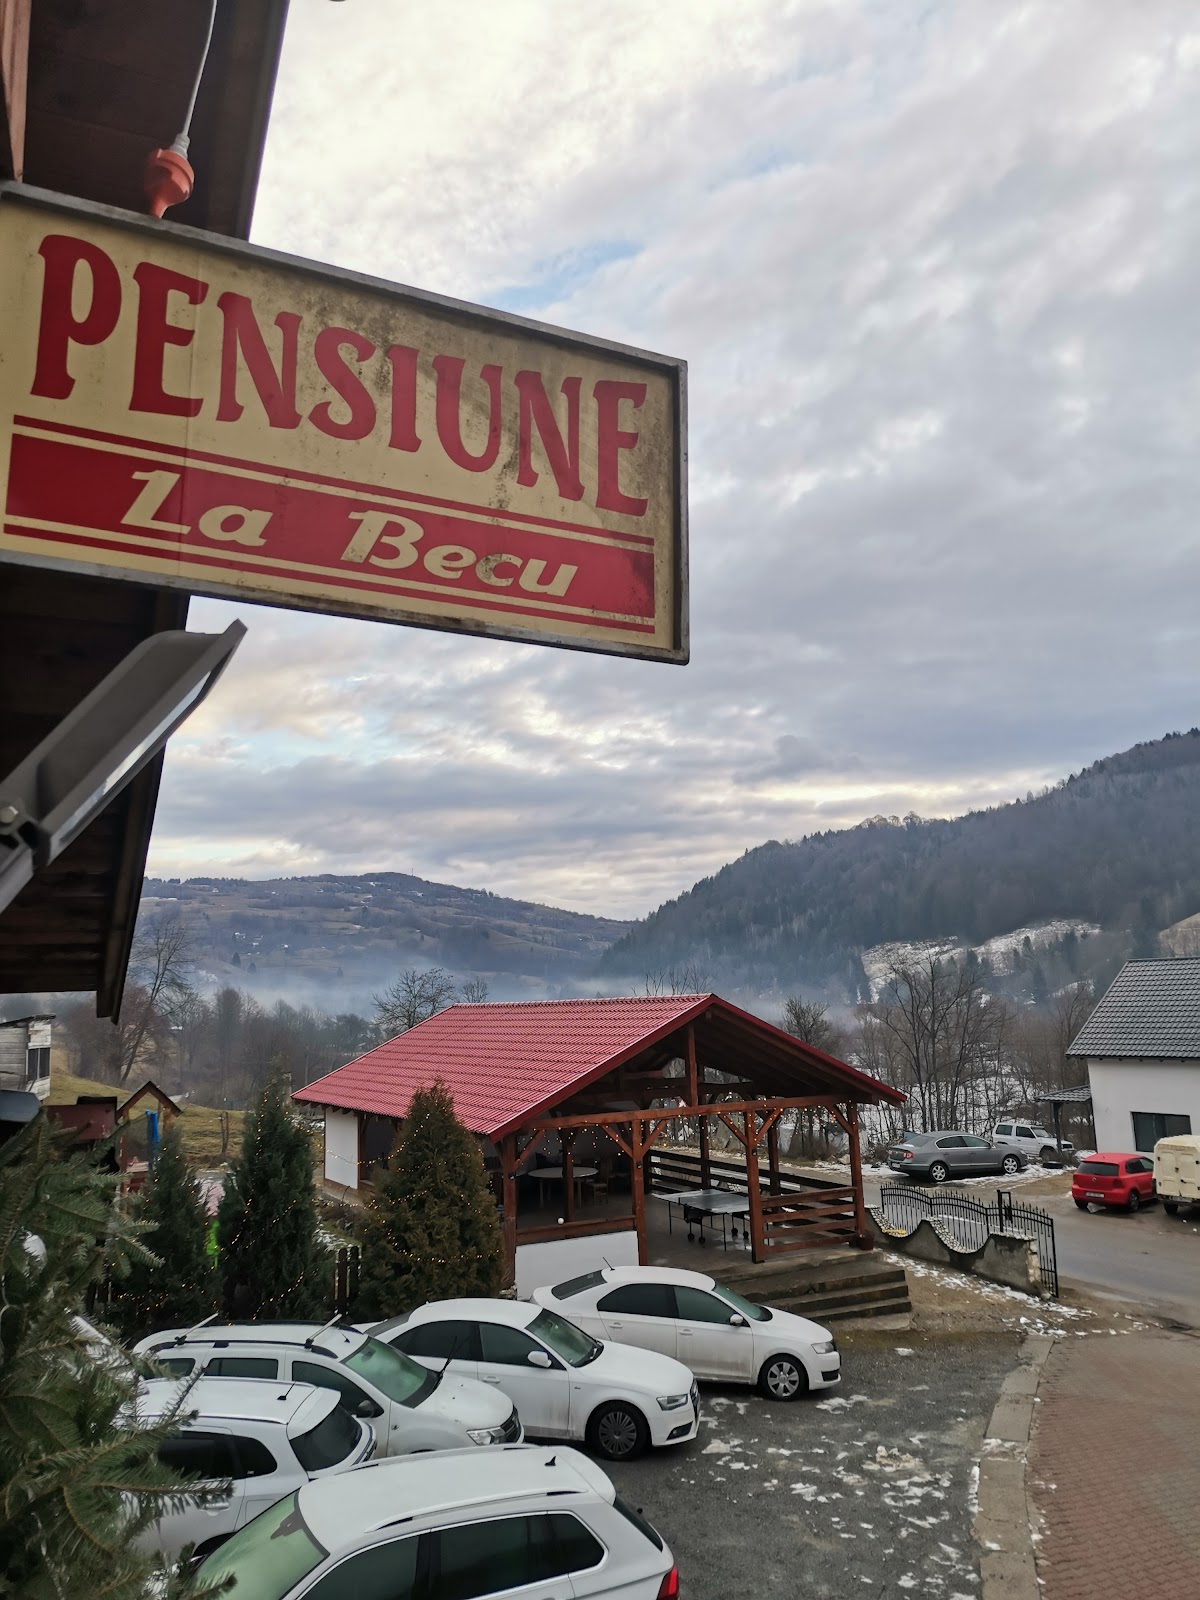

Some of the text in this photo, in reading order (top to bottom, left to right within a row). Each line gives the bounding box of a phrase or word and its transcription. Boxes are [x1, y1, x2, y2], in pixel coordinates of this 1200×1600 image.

[30, 234, 648, 516] PENSIUNE
[120, 469, 578, 597] La Becu
